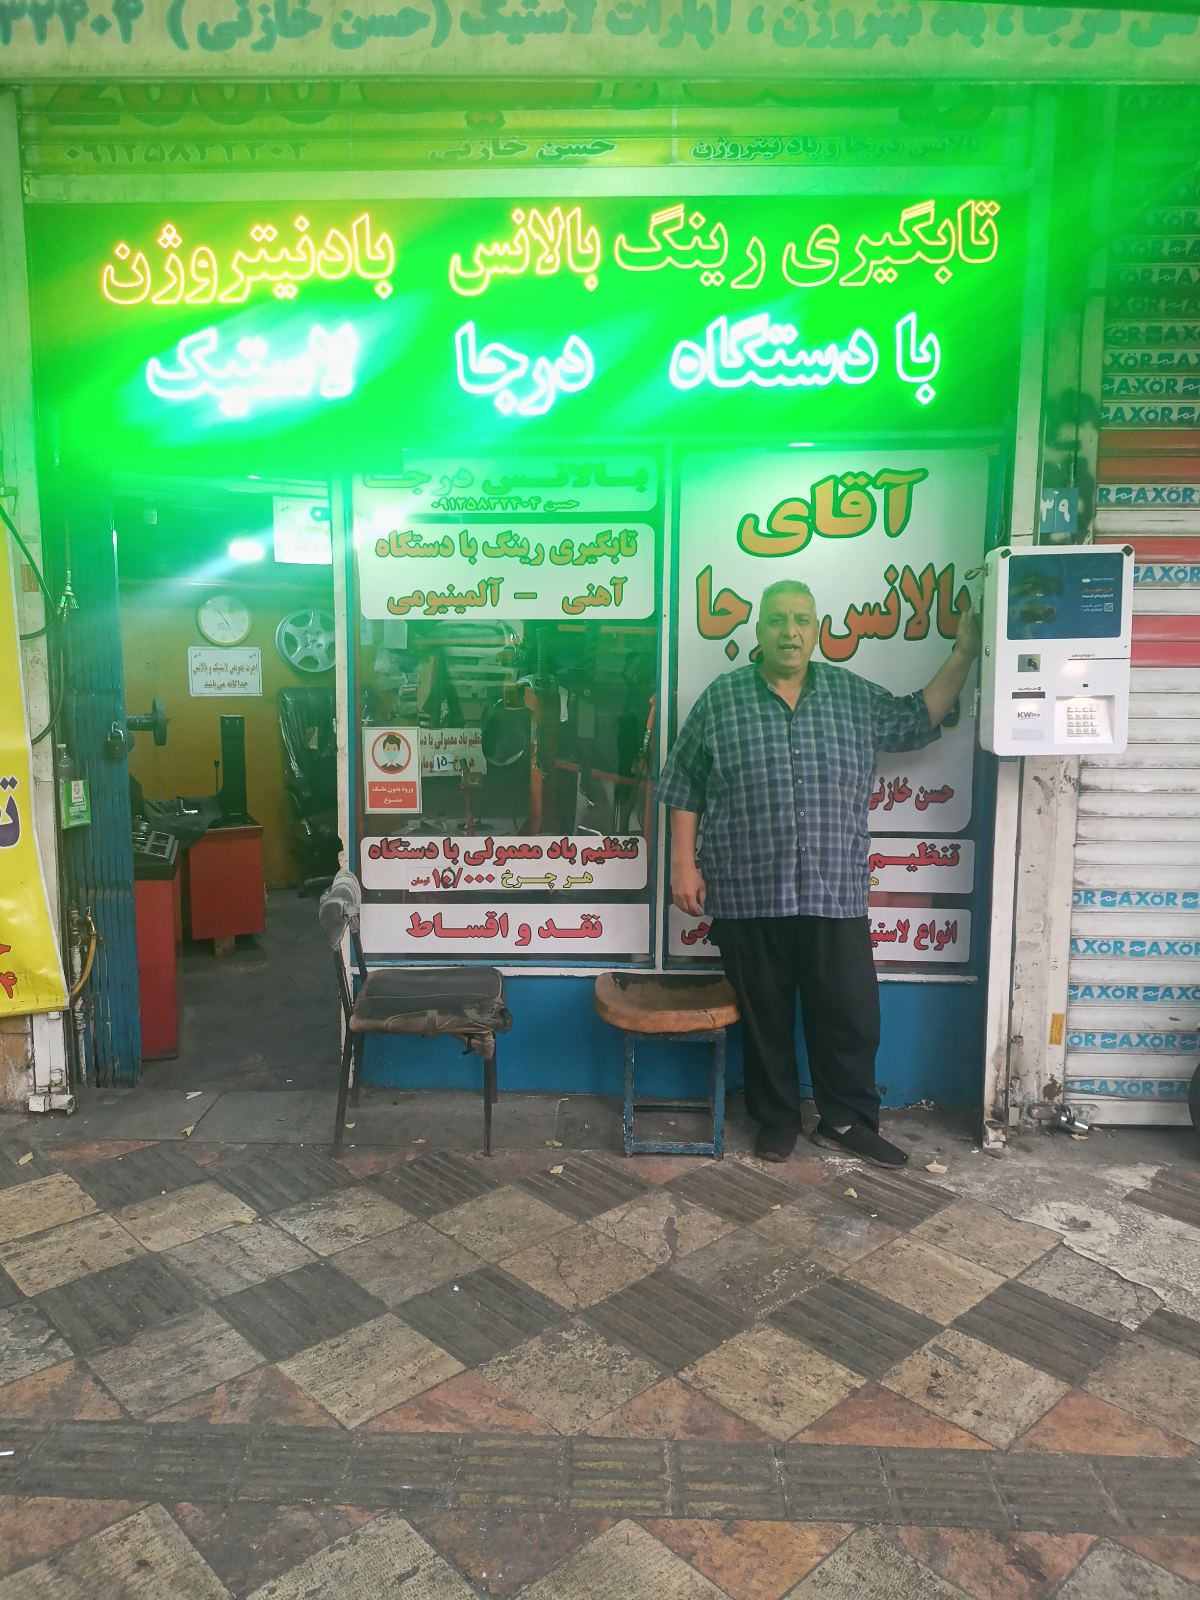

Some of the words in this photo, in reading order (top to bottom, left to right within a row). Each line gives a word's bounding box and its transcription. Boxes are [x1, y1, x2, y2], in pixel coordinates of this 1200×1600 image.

[537, 139, 617, 161] حسن
[690, 136, 782, 161] نیتروژن
[449, 206, 601, 296] بالانس
[615, 202, 766, 289] رینگ
[782, 199, 1000, 288] تابگیری
[668, 312, 880, 390] دستگاه
[895, 311, 941, 406] با
[145, 322, 360, 418] لاستیک
[454, 320, 596, 416] درجا
[362, 467, 475, 496] درجا
[482, 460, 649, 495] بالانس
[543, 499, 581, 513] حسن
[736, 467, 929, 558] آقای
[1040, 498, 1071, 523] ۳۹
[374, 529, 456, 558] دستگاه
[458, 528, 479, 566] با
[549, 528, 639, 566] تابگیری
[387, 576, 504, 616] آلمینیومی
[561, 576, 628, 615] آهنی
[914, 785, 955, 812] حسن
[367, 837, 440, 860] دستگاه
[441, 836, 460, 865] با
[463, 836, 543, 866] معمولی
[546, 836, 578, 866] باد
[580, 836, 640, 866] تنظیم
[868, 841, 962, 873] تنظیم
[501, 869, 558, 890] چرخ
[563, 870, 594, 889] هر
[405, 910, 510, 939] اقساط
[514, 922, 532, 947] و
[537, 912, 603, 939] نقد
[913, 919, 958, 951] انواع
